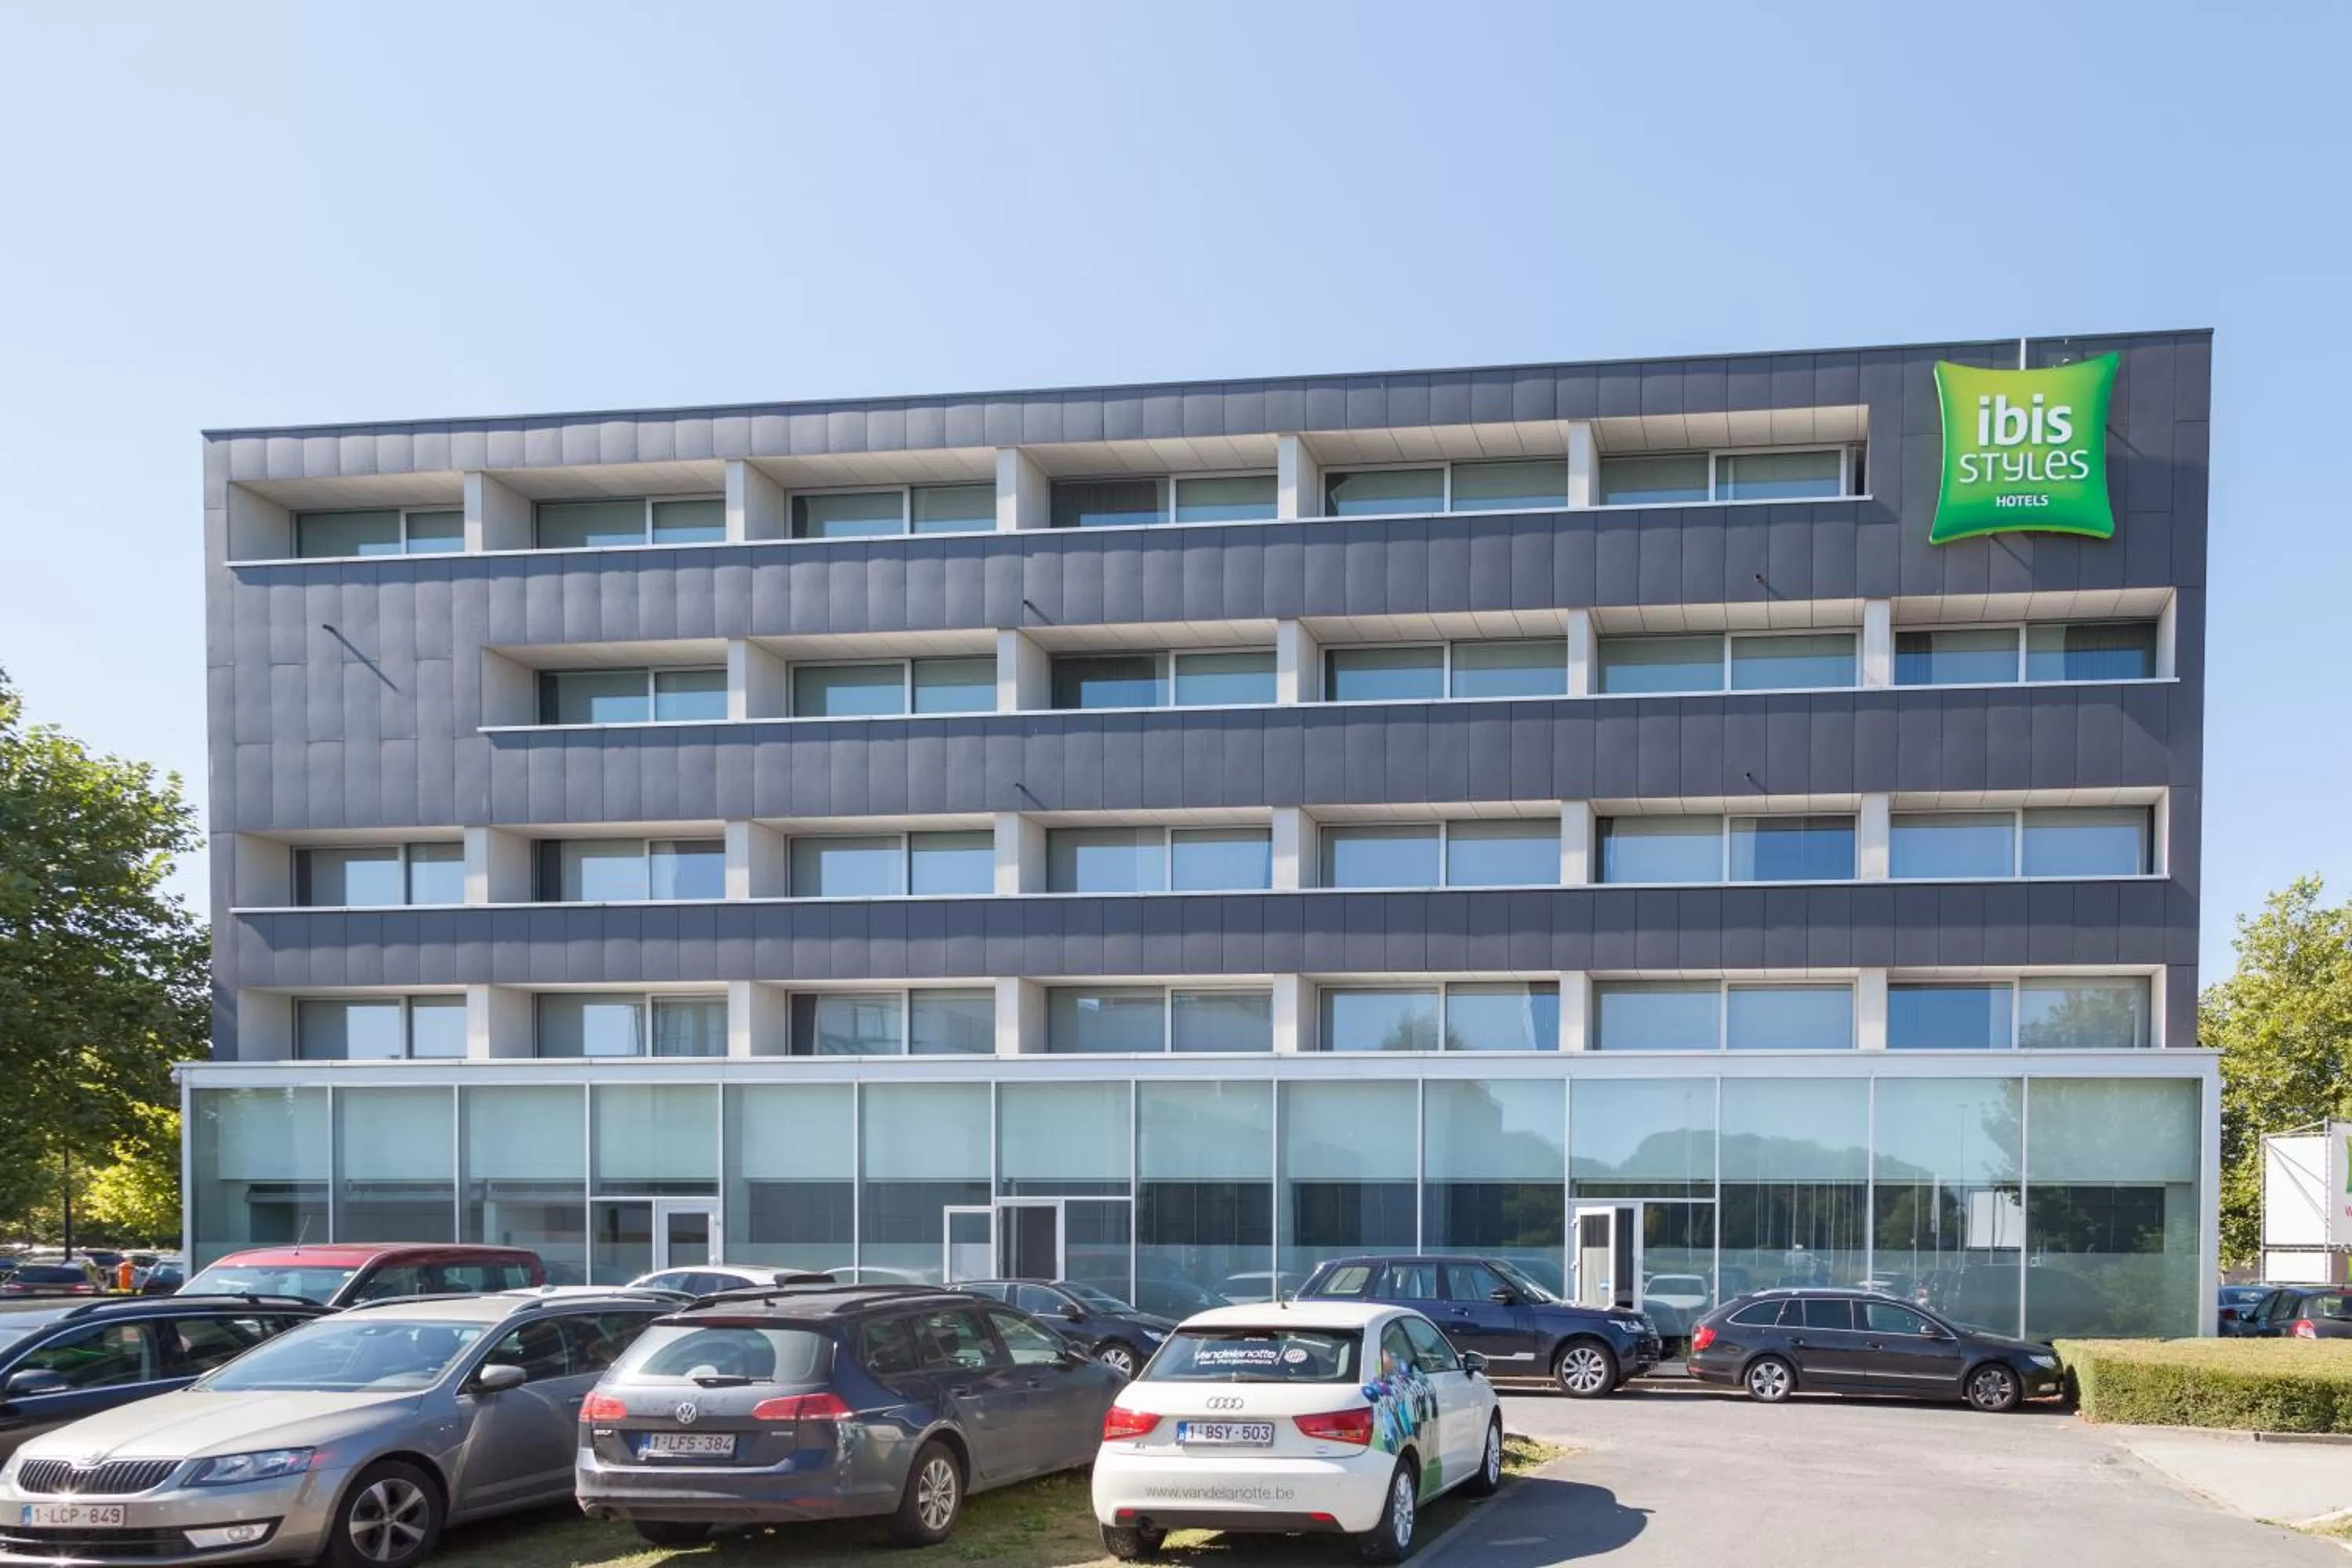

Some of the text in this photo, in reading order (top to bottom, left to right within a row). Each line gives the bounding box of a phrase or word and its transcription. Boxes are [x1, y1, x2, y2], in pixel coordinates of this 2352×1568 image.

[1978, 394, 2072, 445] ibis
[1995, 495, 2049, 507] HOTELS
[1189, 1425, 1270, 1440] 1-BSY-503
[653, 1435, 731, 1450] 1-LFS-384
[35, 1507, 121, 1523] 1-LCP-849
